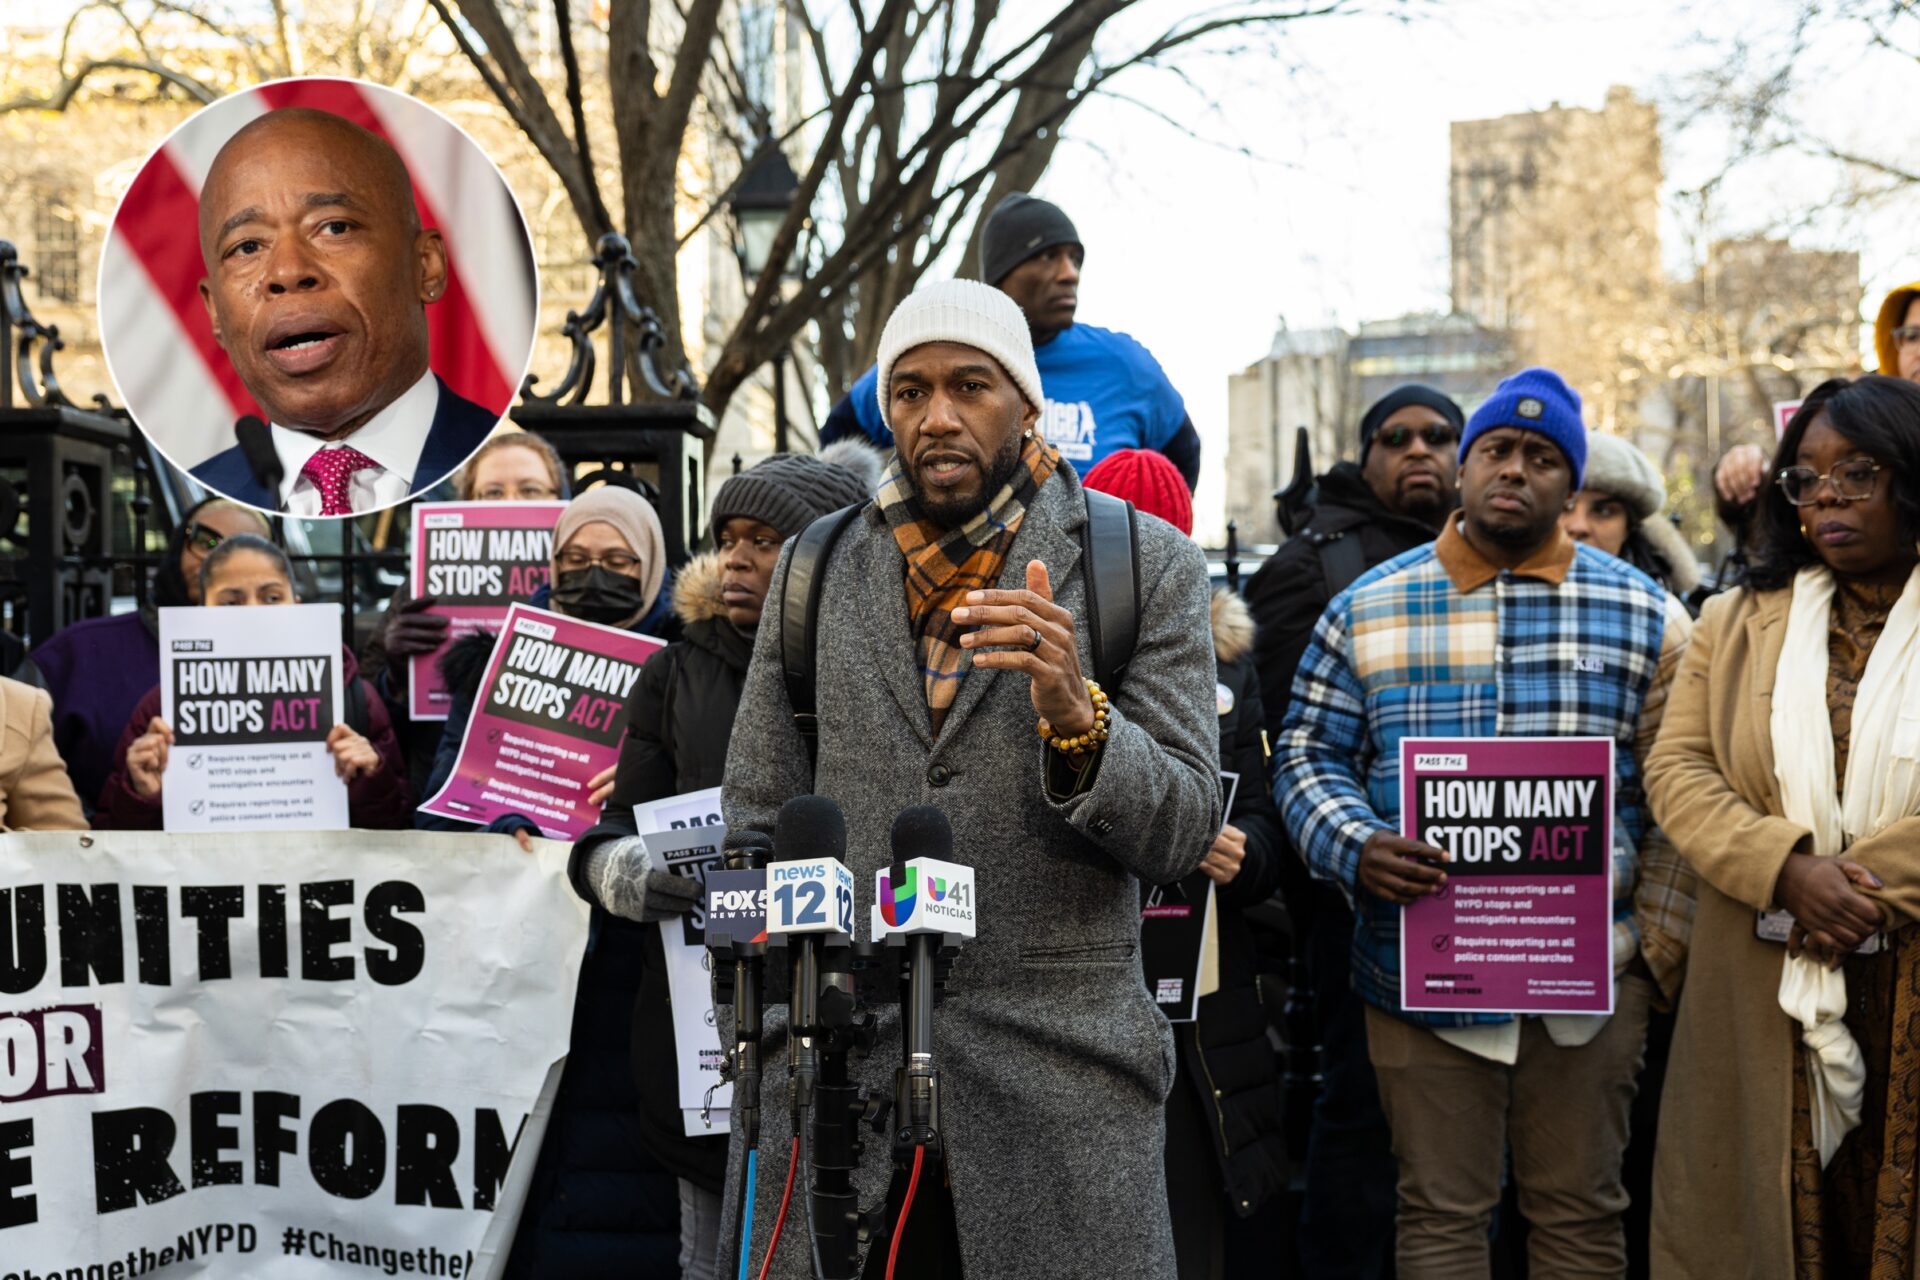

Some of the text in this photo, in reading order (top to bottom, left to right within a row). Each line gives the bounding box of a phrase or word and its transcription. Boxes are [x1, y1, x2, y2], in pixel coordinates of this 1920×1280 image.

[430, 529, 552, 561] HOW MANY
[428, 564, 503, 596] STOPS
[178, 658, 326, 695] HOW MANY
[507, 637, 641, 699] HOW MANY
[178, 697, 321, 735] STOPS ACT
[494, 673, 623, 734] STOPS ACT
[1418, 757, 1441, 766] PASS
[1425, 780, 1597, 818] HOW MANY
[667, 848, 690, 859] PASS
[1425, 825, 1589, 862] STOPS ACT
[774, 864, 826, 881] news
[836, 867, 852, 889] news
[773, 881, 826, 926] 12
[948, 881, 970, 907] 41
[1455, 884, 1575, 896] Requires reporting on all
[1455, 899, 1532, 910] NYPD stops and
[836, 884, 853, 935] 12
[925, 903, 972, 920] NOTICIAS
[1455, 914, 1576, 926] investigative encounters
[0, 879, 426, 994] UNITIES
[1455, 936, 1575, 949] Requires reporting on all
[1455, 952, 1574, 963] police consent searches
[0, 1010, 95, 1097] OR
